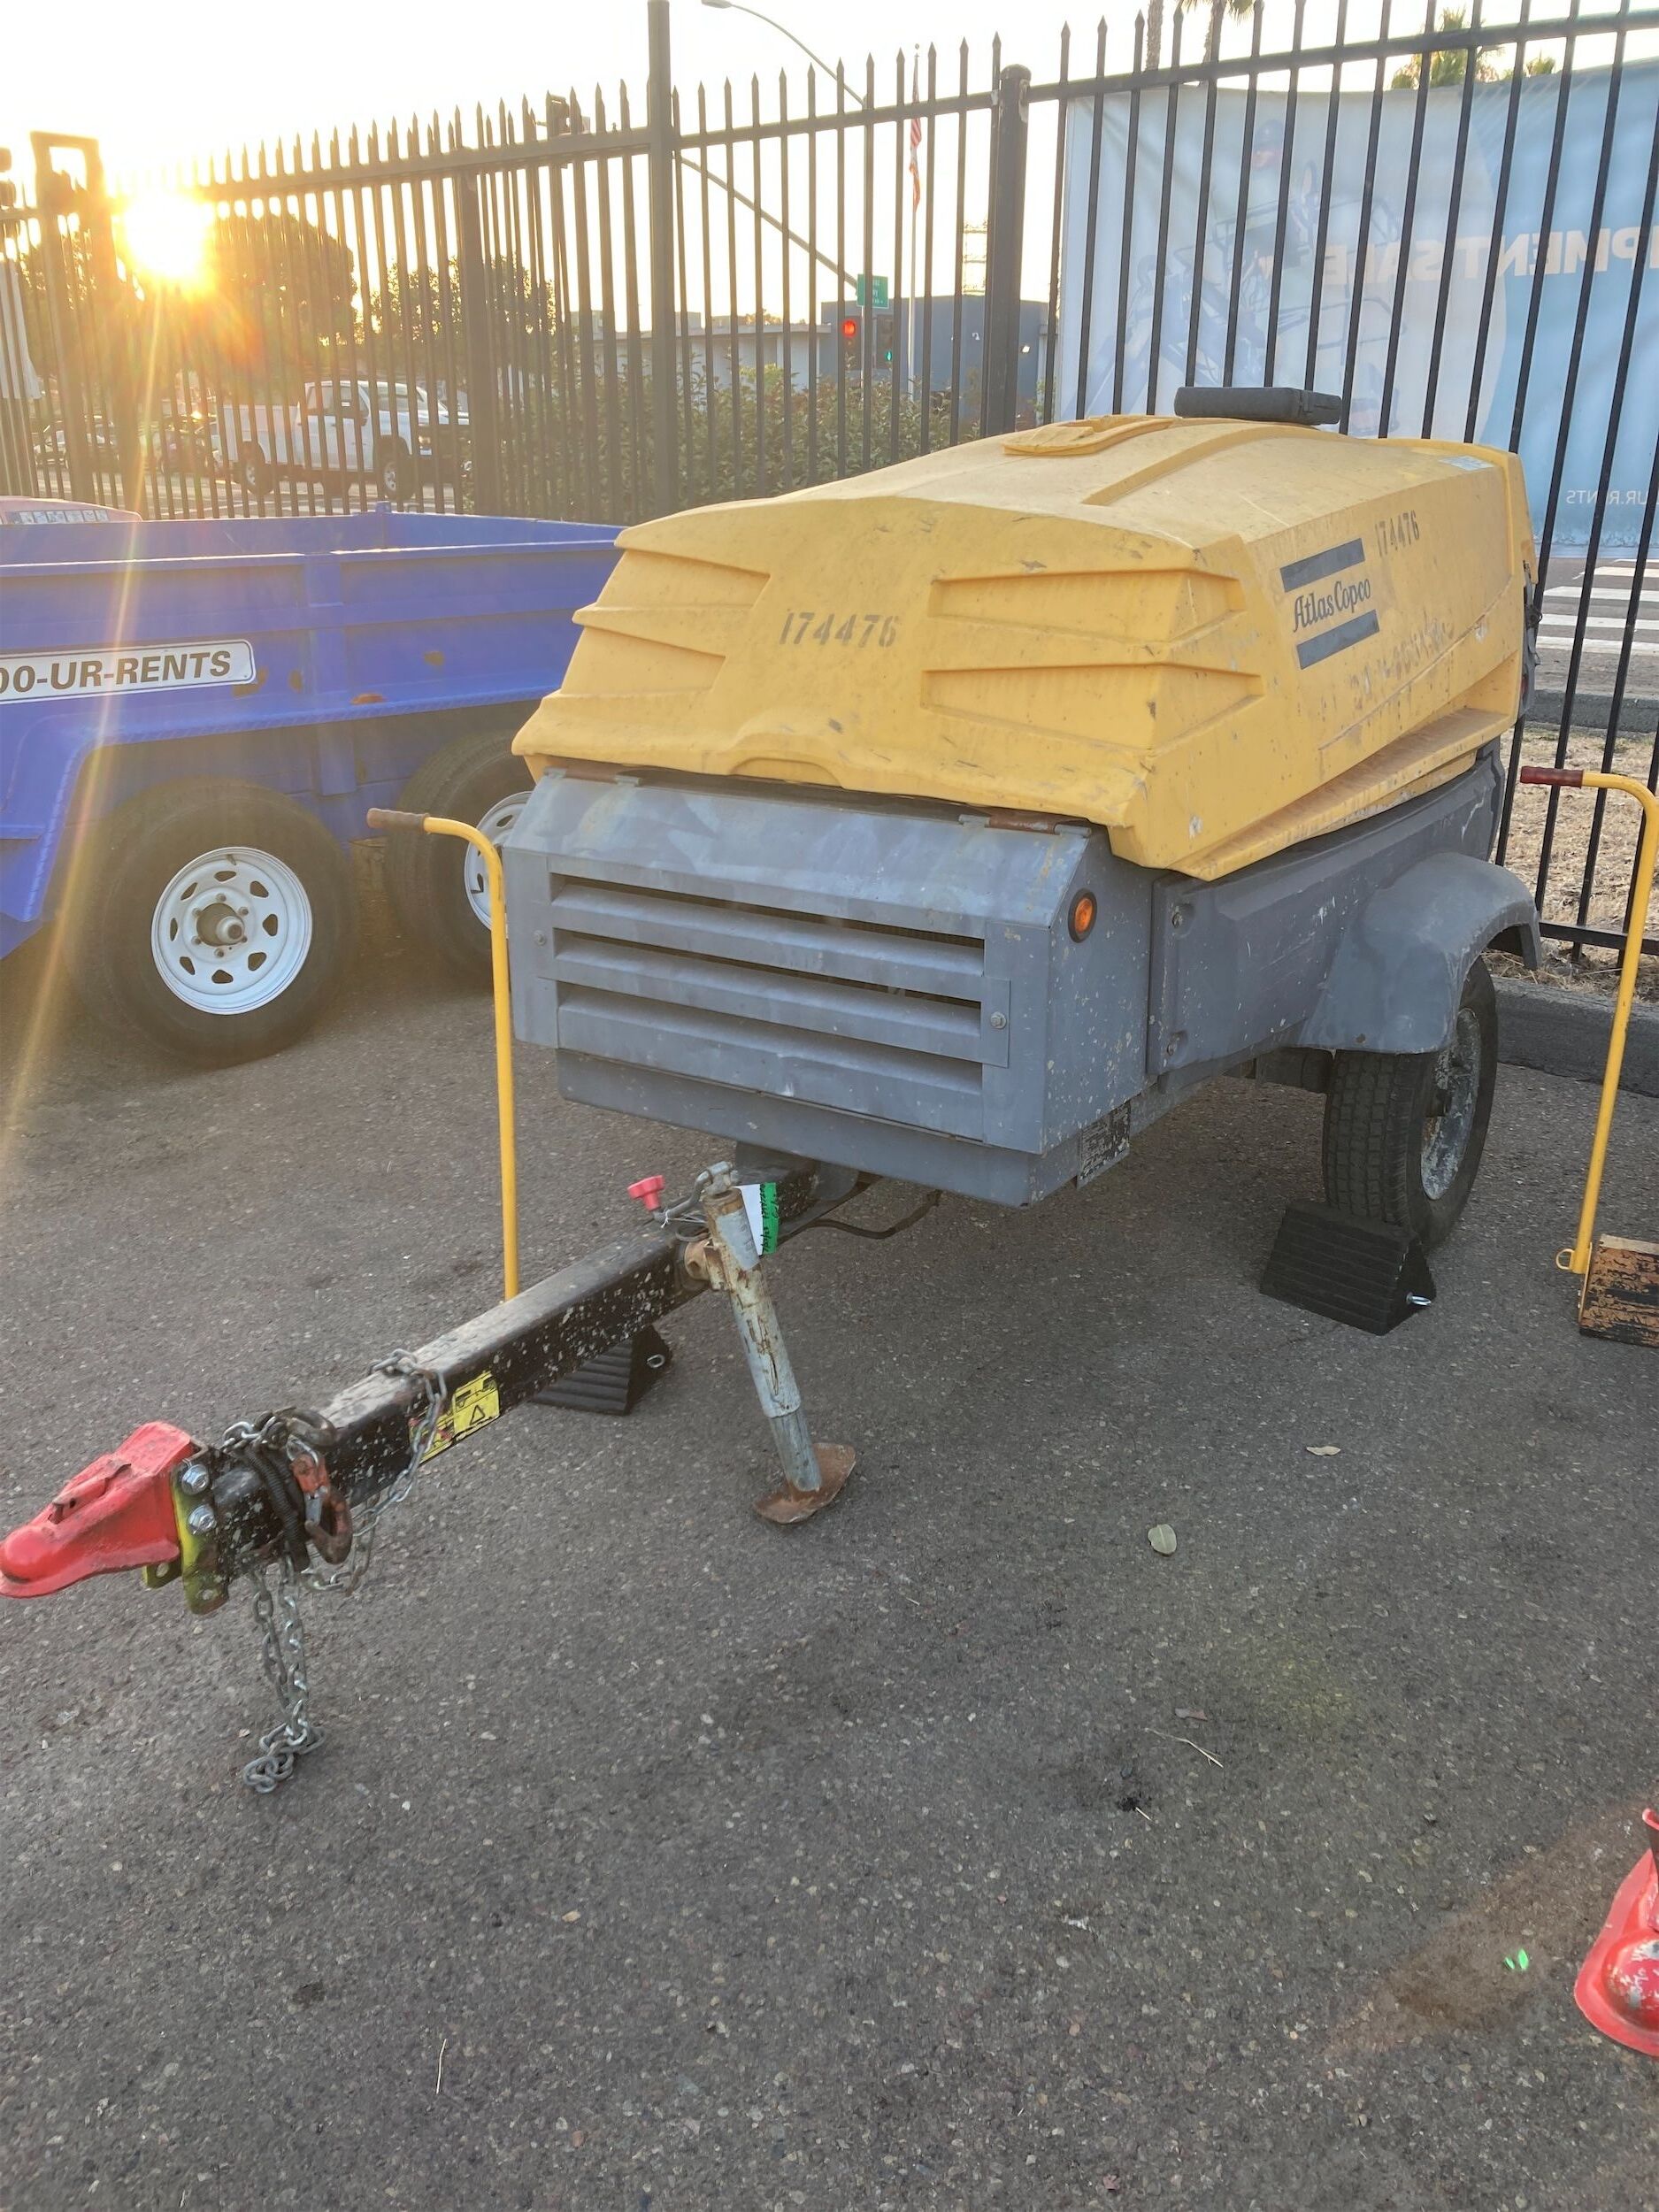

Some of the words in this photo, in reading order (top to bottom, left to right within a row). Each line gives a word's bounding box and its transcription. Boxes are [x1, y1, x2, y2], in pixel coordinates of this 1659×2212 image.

[1374, 509, 1420, 557] 174476
[1293, 592, 1334, 633] Atlas
[1334, 578, 1371, 613] Copco
[779, 612, 899, 648] 174476
